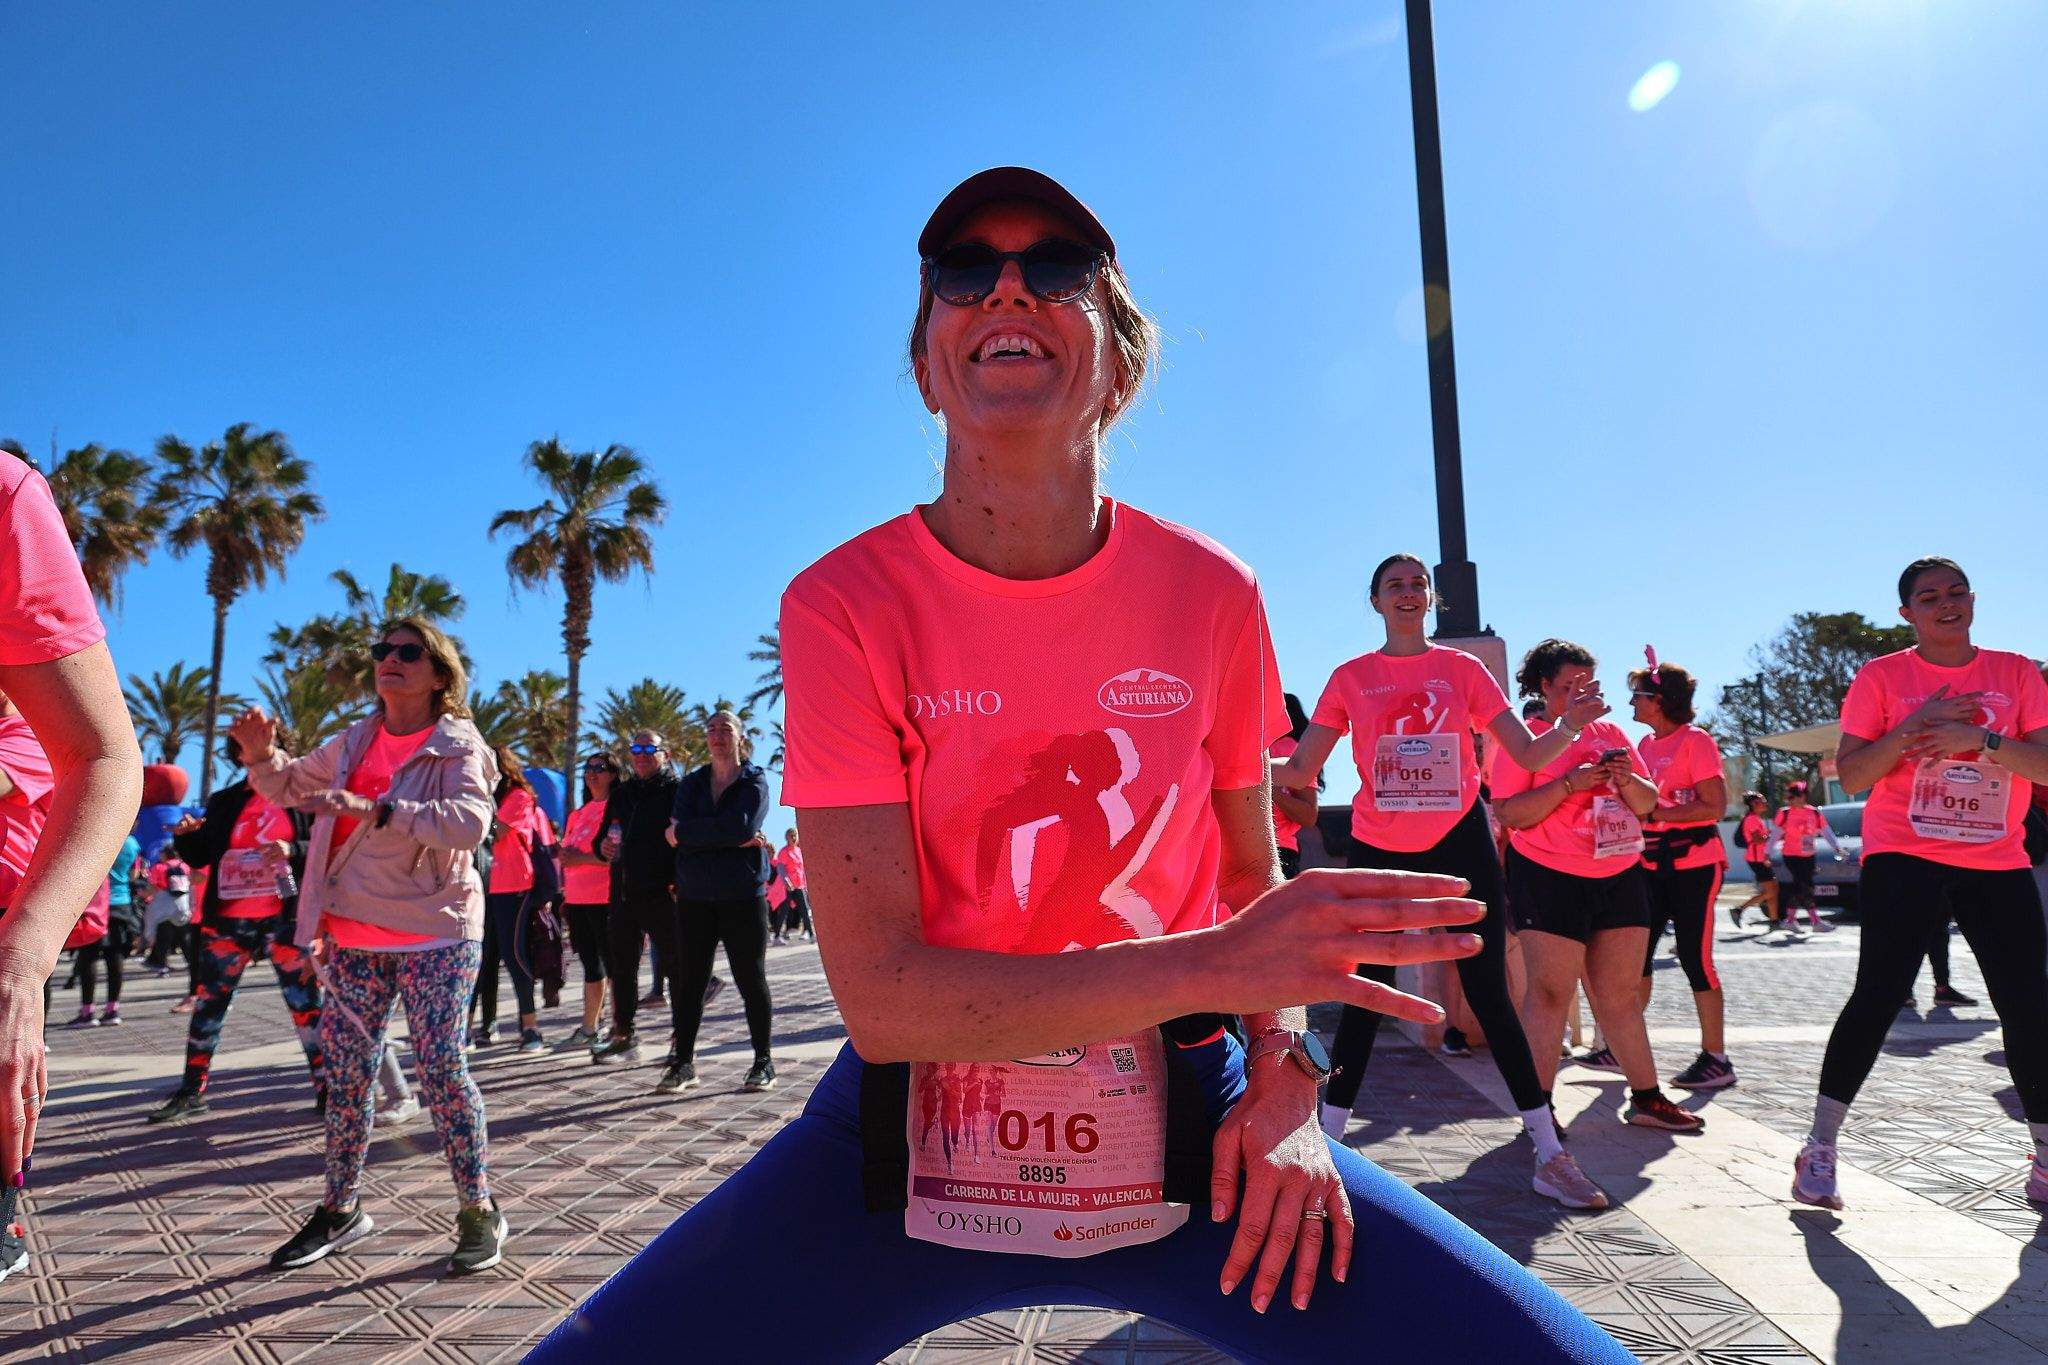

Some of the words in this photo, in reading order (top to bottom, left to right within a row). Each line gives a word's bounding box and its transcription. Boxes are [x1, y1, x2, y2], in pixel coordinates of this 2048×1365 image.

[1106, 686, 1187, 706] ASTURIANA
[1400, 768, 1433, 781] 016
[1943, 795, 1980, 811] 016
[998, 1109, 1100, 1154] 016
[1018, 1164, 1067, 1185] 8895
[945, 1184, 998, 1201] CARRERA
[1001, 1189, 1016, 1201] DE
[1020, 1190, 1036, 1203] LA
[1039, 1191, 1081, 1207] MUJER
[1092, 1188, 1153, 1206] VALENCIA
[937, 1210, 1022, 1236] OYSHO
[1075, 1217, 1158, 1241] Santander
